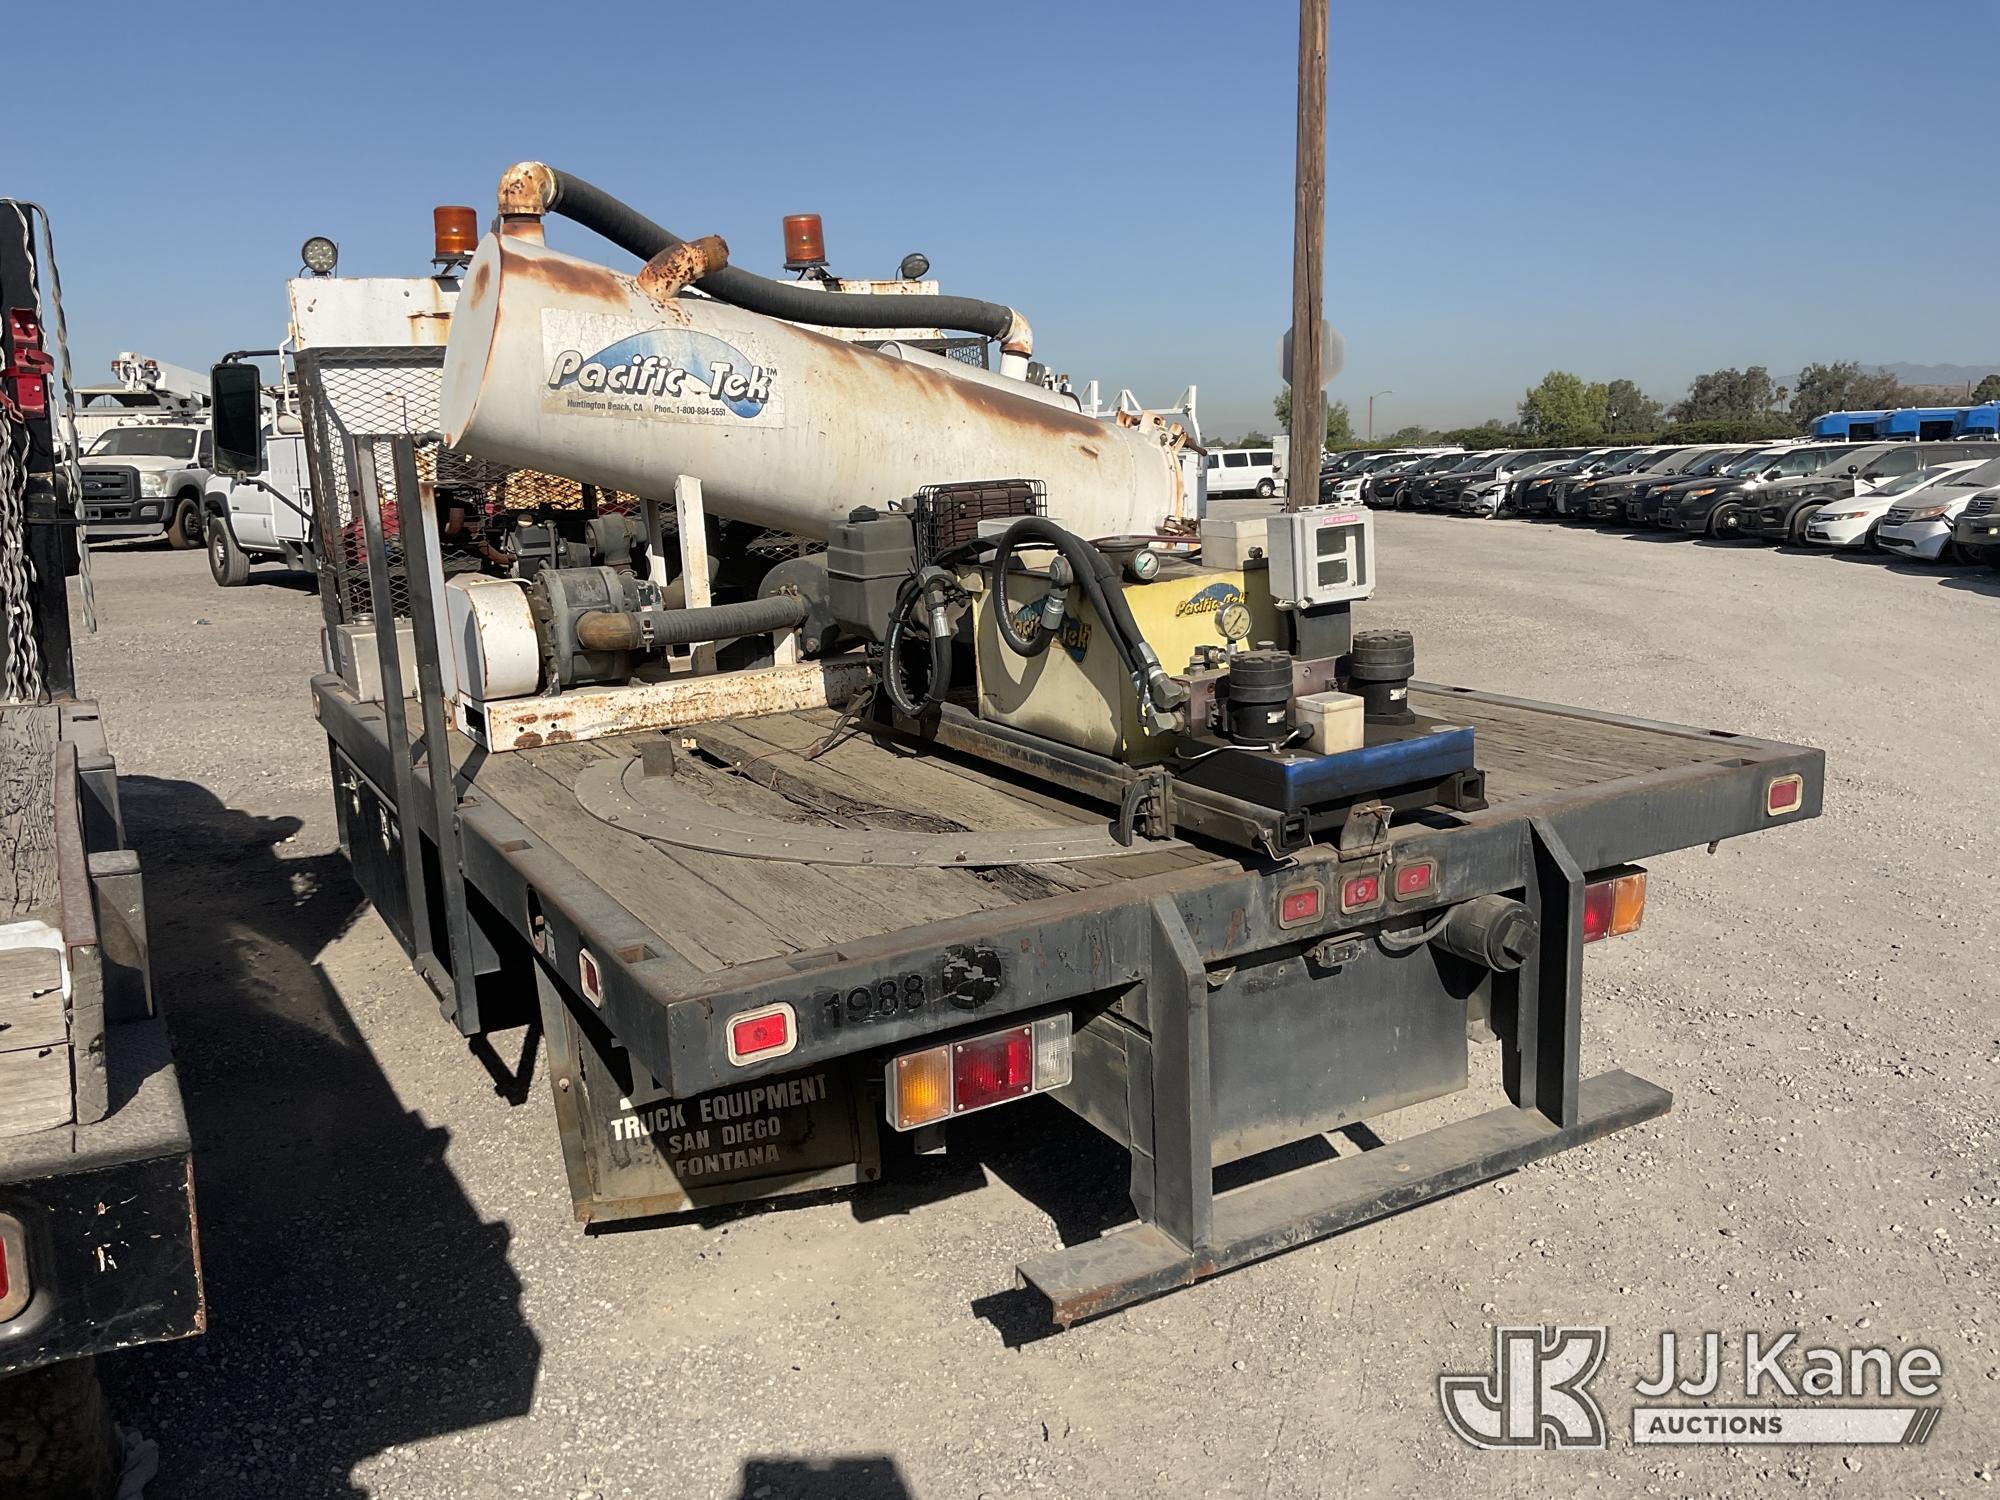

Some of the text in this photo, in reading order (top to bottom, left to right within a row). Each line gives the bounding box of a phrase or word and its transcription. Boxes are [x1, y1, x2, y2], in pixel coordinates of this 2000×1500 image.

[548, 349, 685, 397] Pacific
[709, 360, 773, 404] Tek
[567, 399, 643, 412] Huntington Beach, CA
[654, 404, 674, 413] Phon
[1175, 596, 1219, 617] Pacific
[610, 1073, 828, 1141] TRUCK EQUIPMENT
[668, 1116, 782, 1154] SAN DIEGO
[675, 1143, 781, 1178] FONTANA
